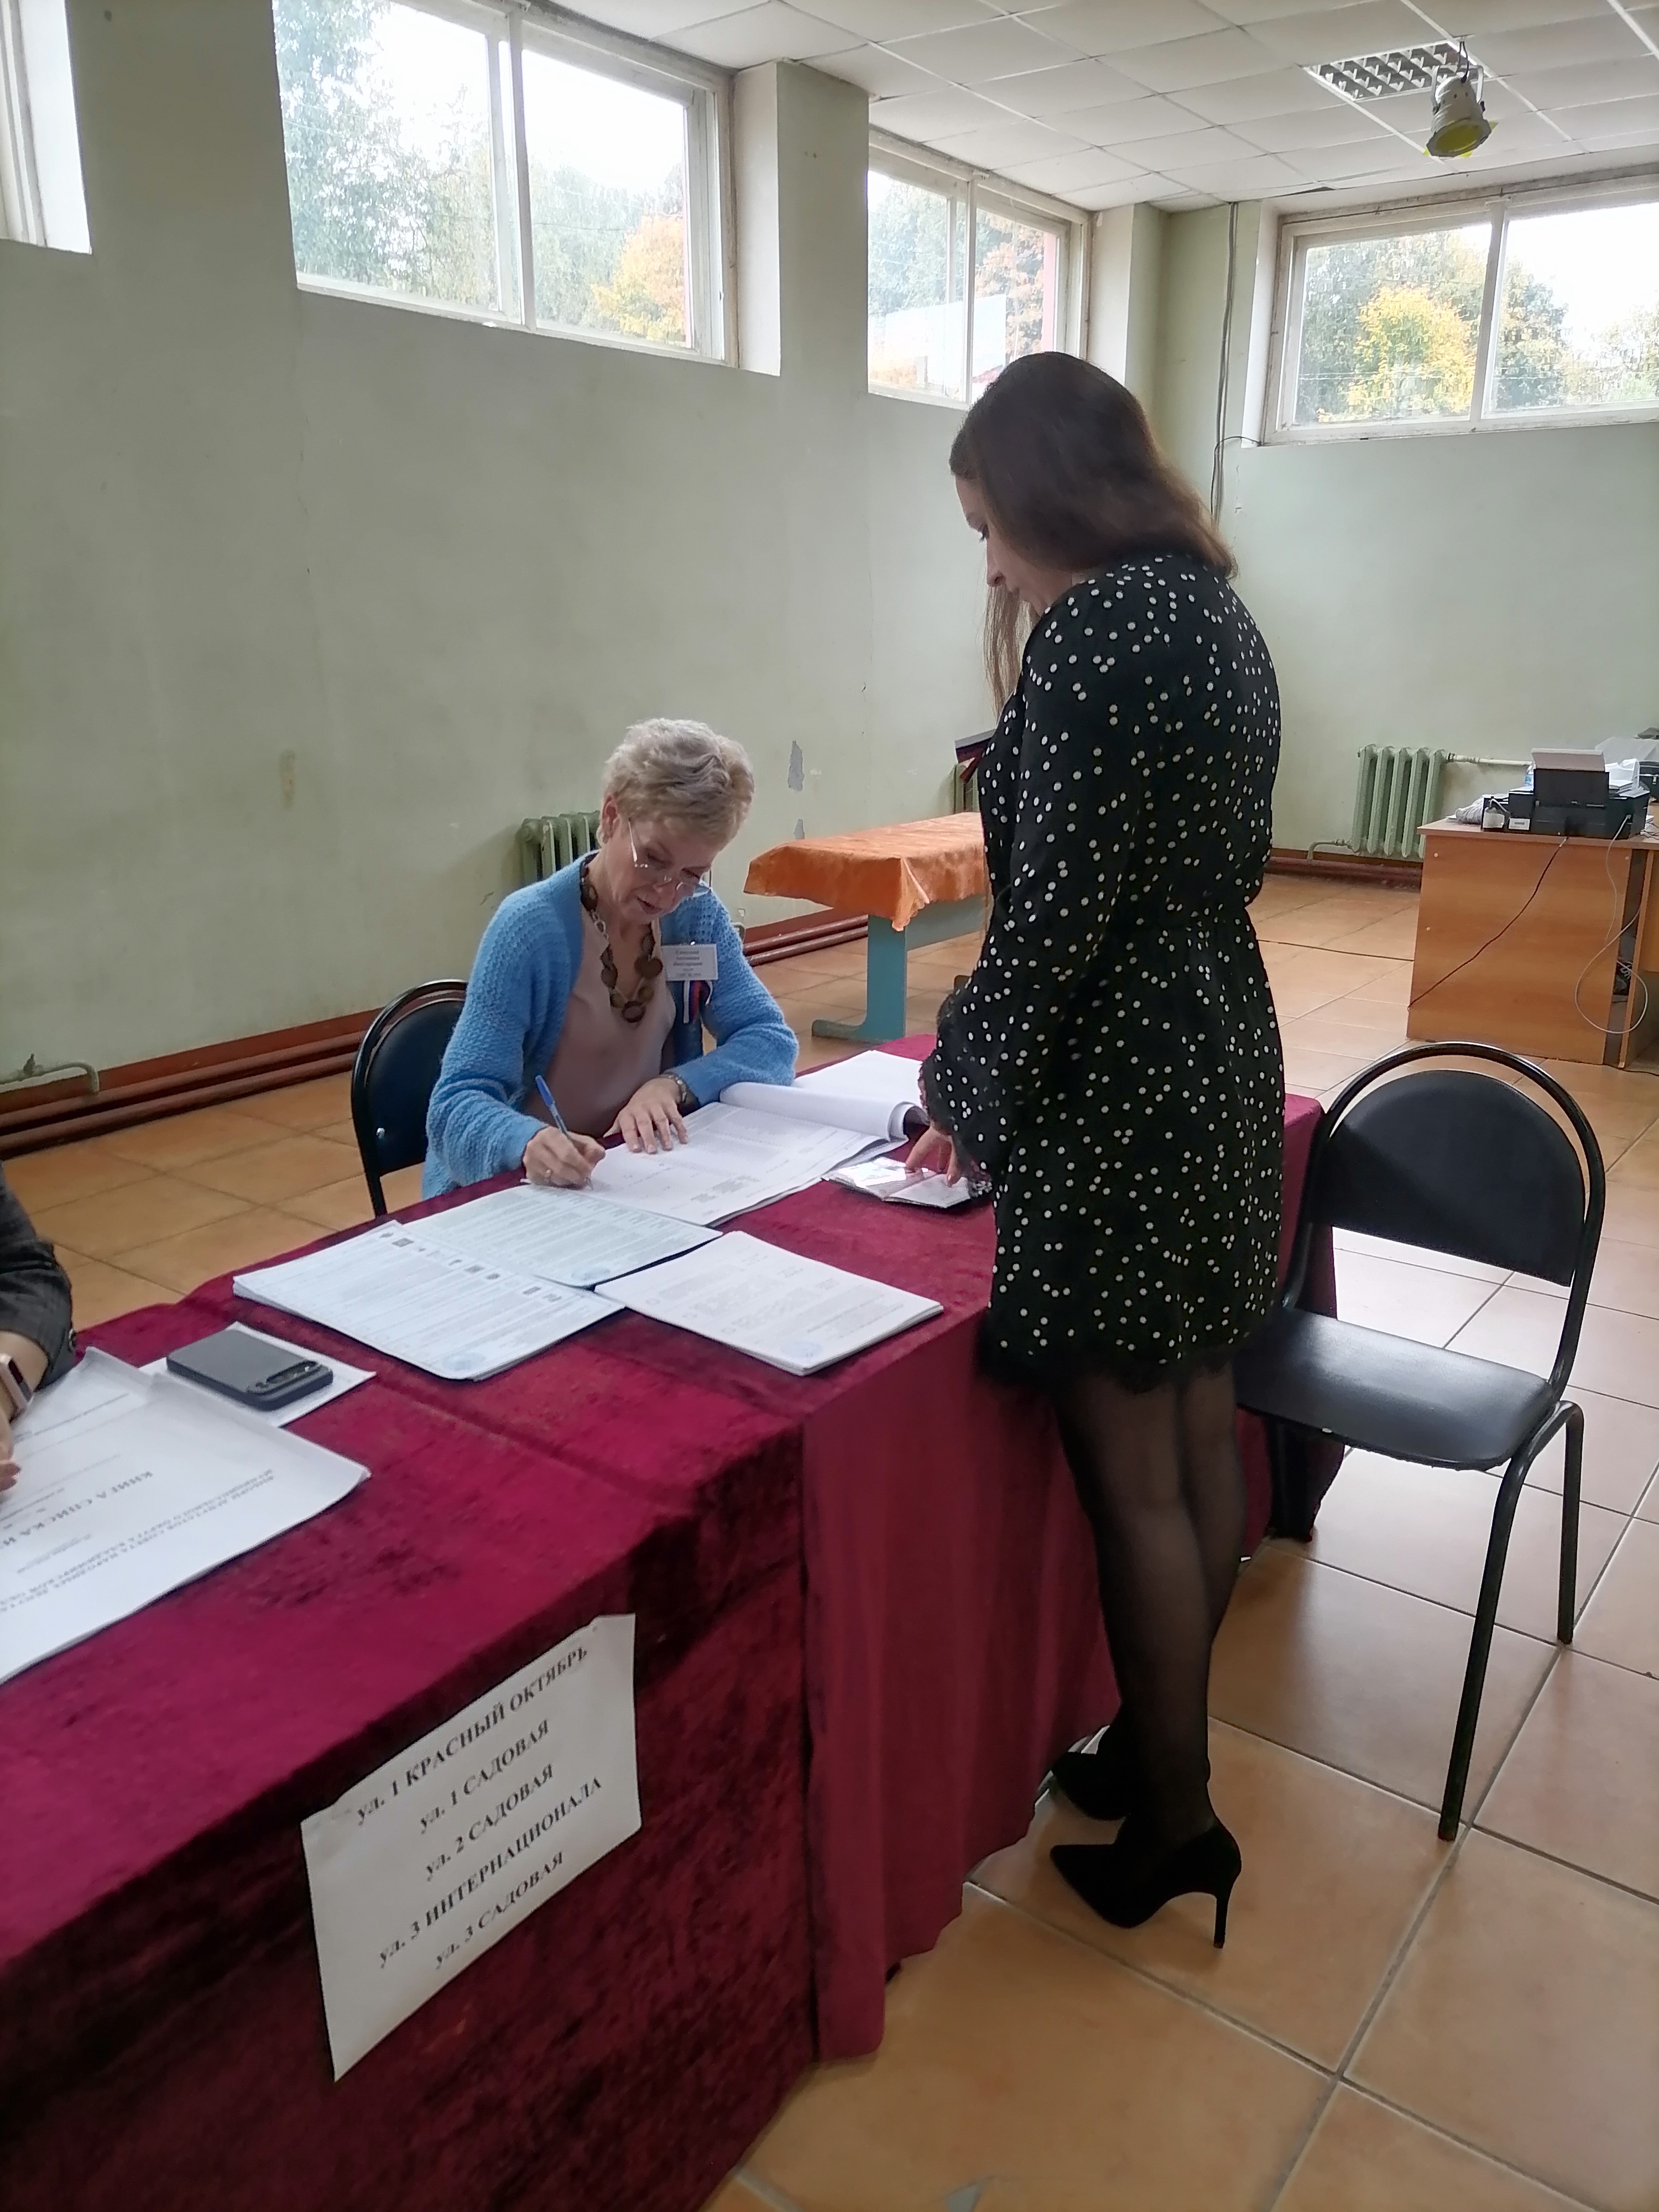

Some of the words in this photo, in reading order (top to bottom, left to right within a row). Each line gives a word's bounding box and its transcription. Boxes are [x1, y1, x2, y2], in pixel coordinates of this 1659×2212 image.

[358, 1797, 385, 1826] ул.
[392, 1780, 399, 1797] 1
[405, 1701, 505, 1787] КРАСНЫЙ
[509, 1646, 587, 1712] ОКТЯБРЬ
[420, 1807, 445, 1834] ул.
[451, 1790, 457, 1806] 1
[463, 1719, 549, 1795] САДОВАЯ
[380, 1939, 405, 1969] ул.
[411, 1921, 420, 1940] 3
[425, 1777, 602, 1927] ИНТЕРНАЦИОНАЛА
[425, 1854, 451, 1881] ул.
[455, 1836, 465, 1854] 2
[468, 1763, 553, 1841] САДОВАЯ
[436, 1943, 460, 1969] ул.
[465, 1926, 474, 1942] 3
[477, 1851, 563, 1929] САДОВАЯ
